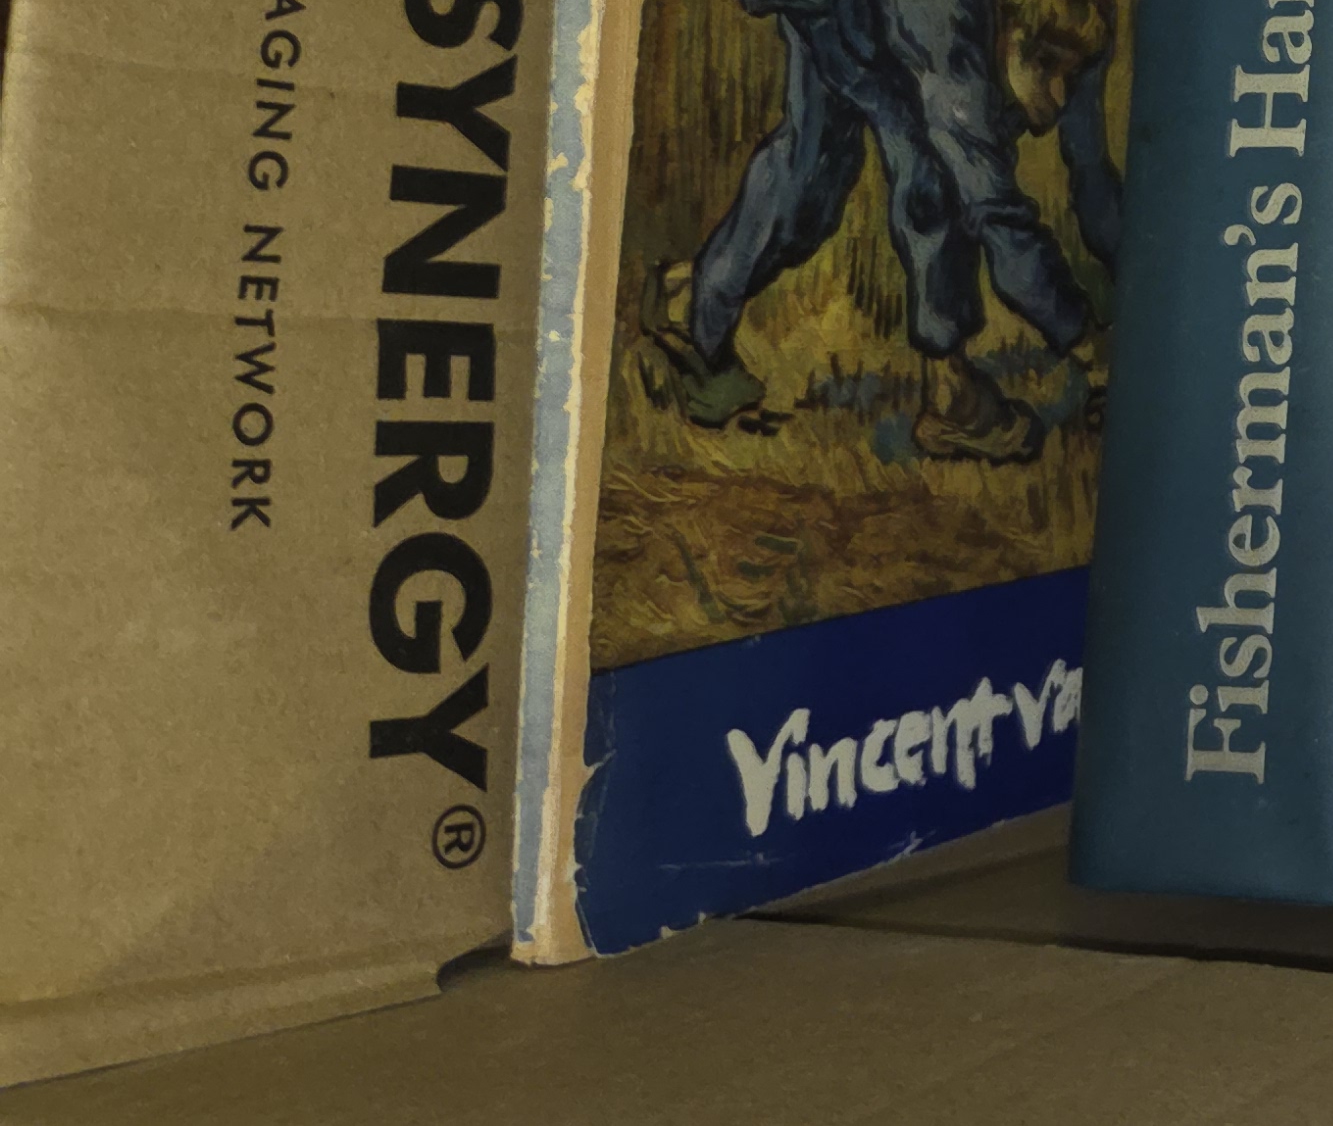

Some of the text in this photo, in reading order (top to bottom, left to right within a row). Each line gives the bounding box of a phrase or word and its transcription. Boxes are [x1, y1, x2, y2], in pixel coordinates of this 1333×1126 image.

[231, 224, 284, 533] NETWORK
[1184, 181, 1303, 785] Fisherman's
[726, 658, 1083, 838] Vincent va
